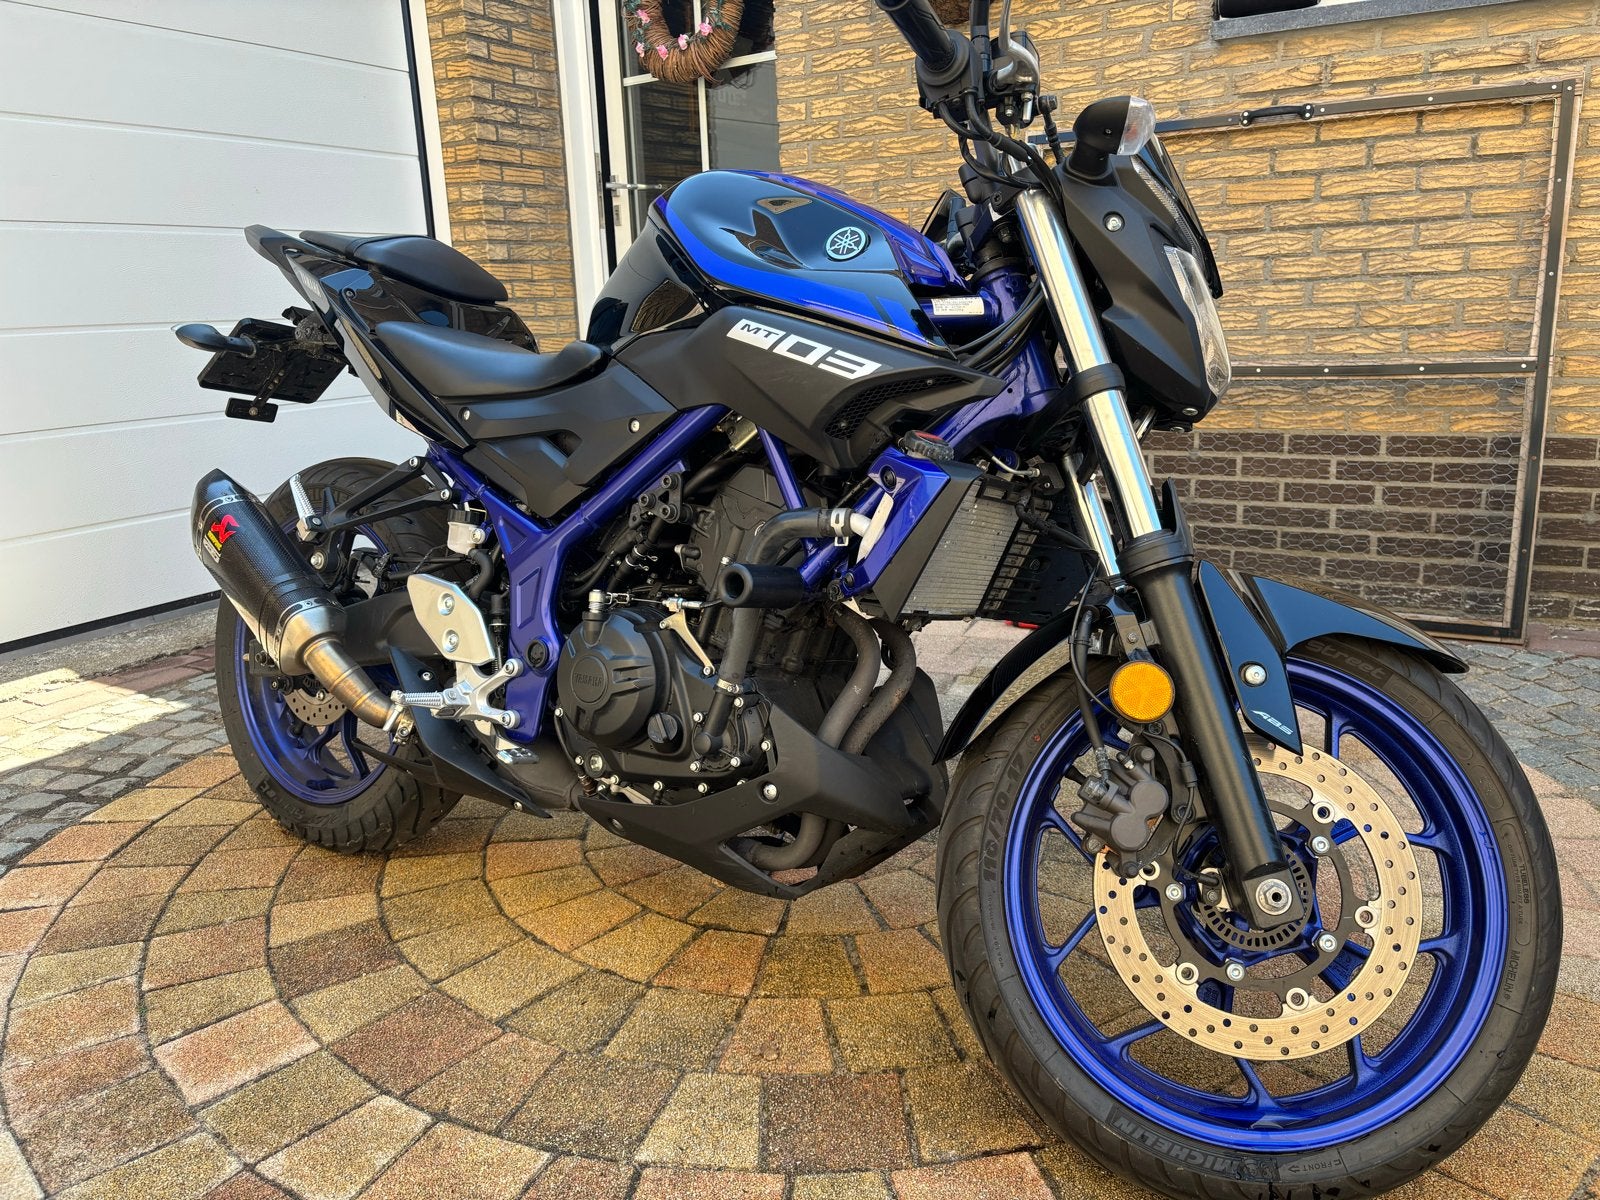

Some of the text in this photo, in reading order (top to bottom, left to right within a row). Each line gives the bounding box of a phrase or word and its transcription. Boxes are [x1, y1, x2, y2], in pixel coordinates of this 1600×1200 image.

[740, 323, 882, 380] MT 03
[1305, 640, 1387, 680] Street
[1251, 710, 1293, 735] ABS
[1112, 1115, 1241, 1175] MICHELIN
[1303, 1161, 1332, 1171] FRONT
